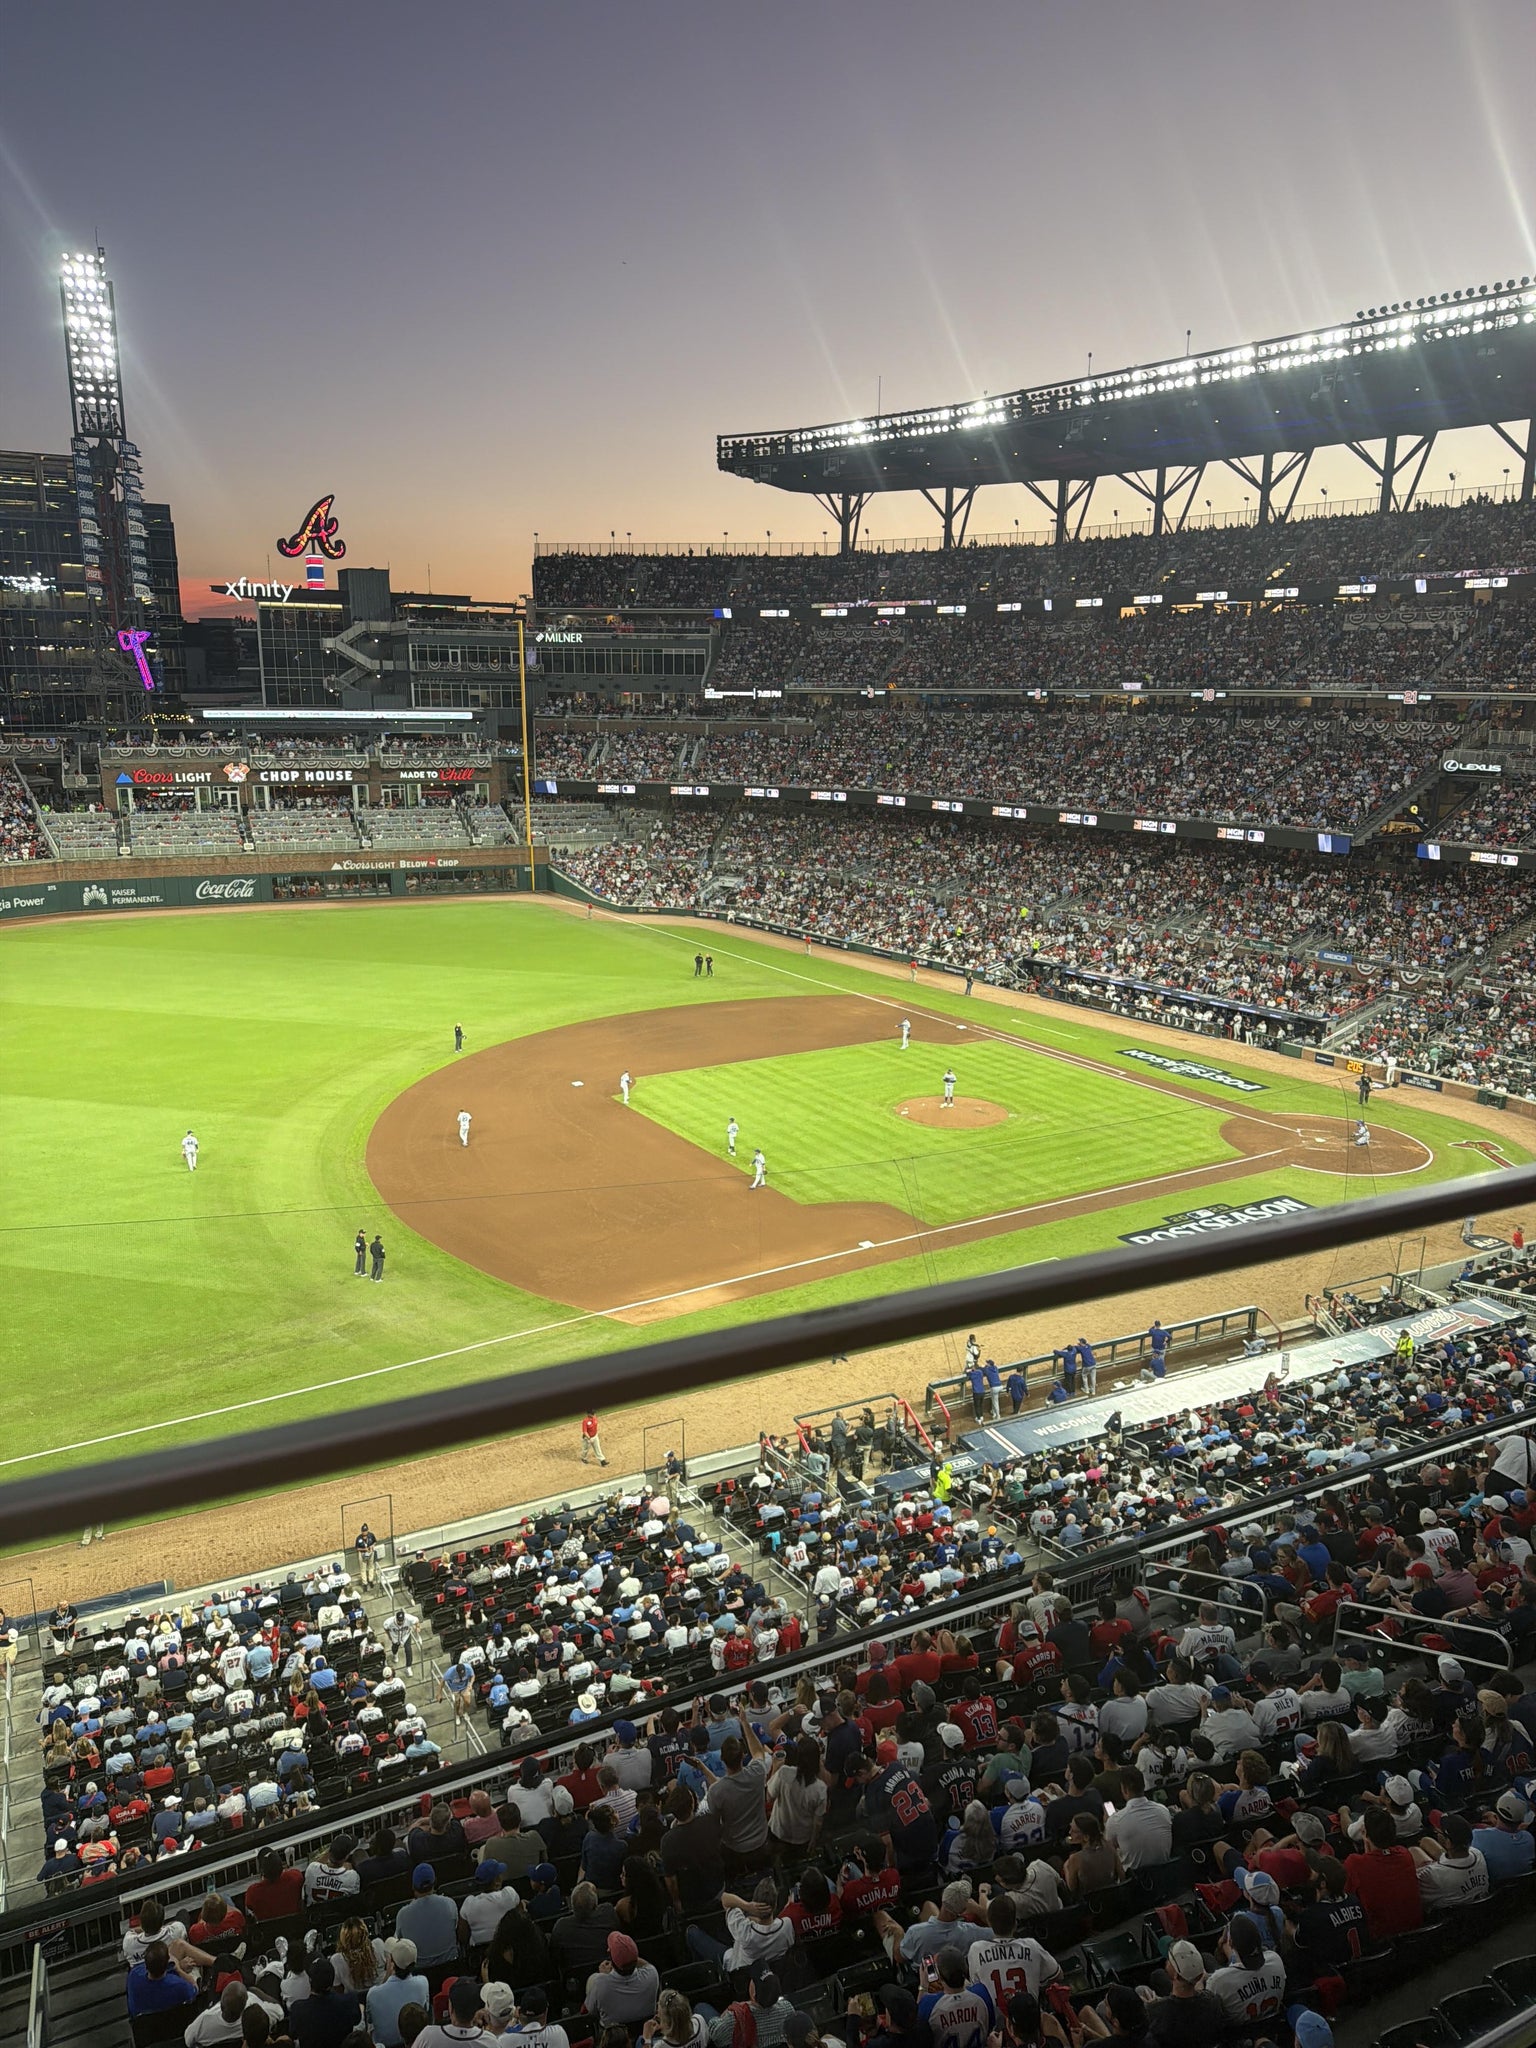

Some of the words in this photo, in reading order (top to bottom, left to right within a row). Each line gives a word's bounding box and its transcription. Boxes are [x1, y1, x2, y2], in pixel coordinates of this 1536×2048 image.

[225, 577, 294, 603] xfinity
[544, 632, 583, 643] MILNER
[400, 771, 425, 779] MADE
[427, 771, 438, 779] TO
[439, 768, 475, 781] Chill
[1460, 763, 1501, 772] LEXUS
[133, 769, 173, 783] Coors
[175, 772, 212, 783] LIGHT
[260, 771, 300, 782] CHOP
[305, 771, 353, 781] HOUSE
[343, 860, 371, 870] Coors
[400, 860, 428, 868] BELOW
[437, 859, 459, 867] CHOP
[196, 879, 257, 899] Coca-Cola
[14, 897, 45, 909] Power
[112, 896, 161, 905] PERMANENTE
[1124, 1050, 1263, 1091] POSTSEASON
[1129, 1198, 1308, 1245] POSTSEASON
[1033, 1411, 1101, 1437] WELCOME
[1040, 1515, 1052, 1524] 42
[793, 1550, 805, 1562] 10
[1201, 1634, 1229, 1645] MADDUX
[226, 1658, 241, 1669] 27
[1027, 1653, 1050, 1669] HARRIS
[233, 1701, 246, 1713] 13
[1274, 1699, 1294, 1712] RILEY
[971, 1714, 997, 1742] 13
[1276, 1712, 1299, 1731] 27
[682, 1743, 689, 1751] JR
[967, 1767, 977, 1780] JR
[884, 1771, 905, 1794] HARRIS
[891, 1781, 929, 1826] 23
[949, 1780, 974, 1811] 13
[1241, 1798, 1268, 1816] AARON
[1010, 1813, 1036, 1832] HARRIS
[316, 1876, 344, 1890] STUART
[1460, 1875, 1486, 1894] ALBIES
[888, 1885, 899, 1898] JR
[801, 1913, 831, 1931] OLSON
[1329, 1906, 1363, 1927] ALBIES
[1346, 1927, 1362, 1960] 1
[990, 1967, 1028, 2003] 13
[1237, 1977, 1267, 2001] ACUÑA
[1271, 1976, 1281, 1989] JR
[940, 2007, 977, 2029] AARON
